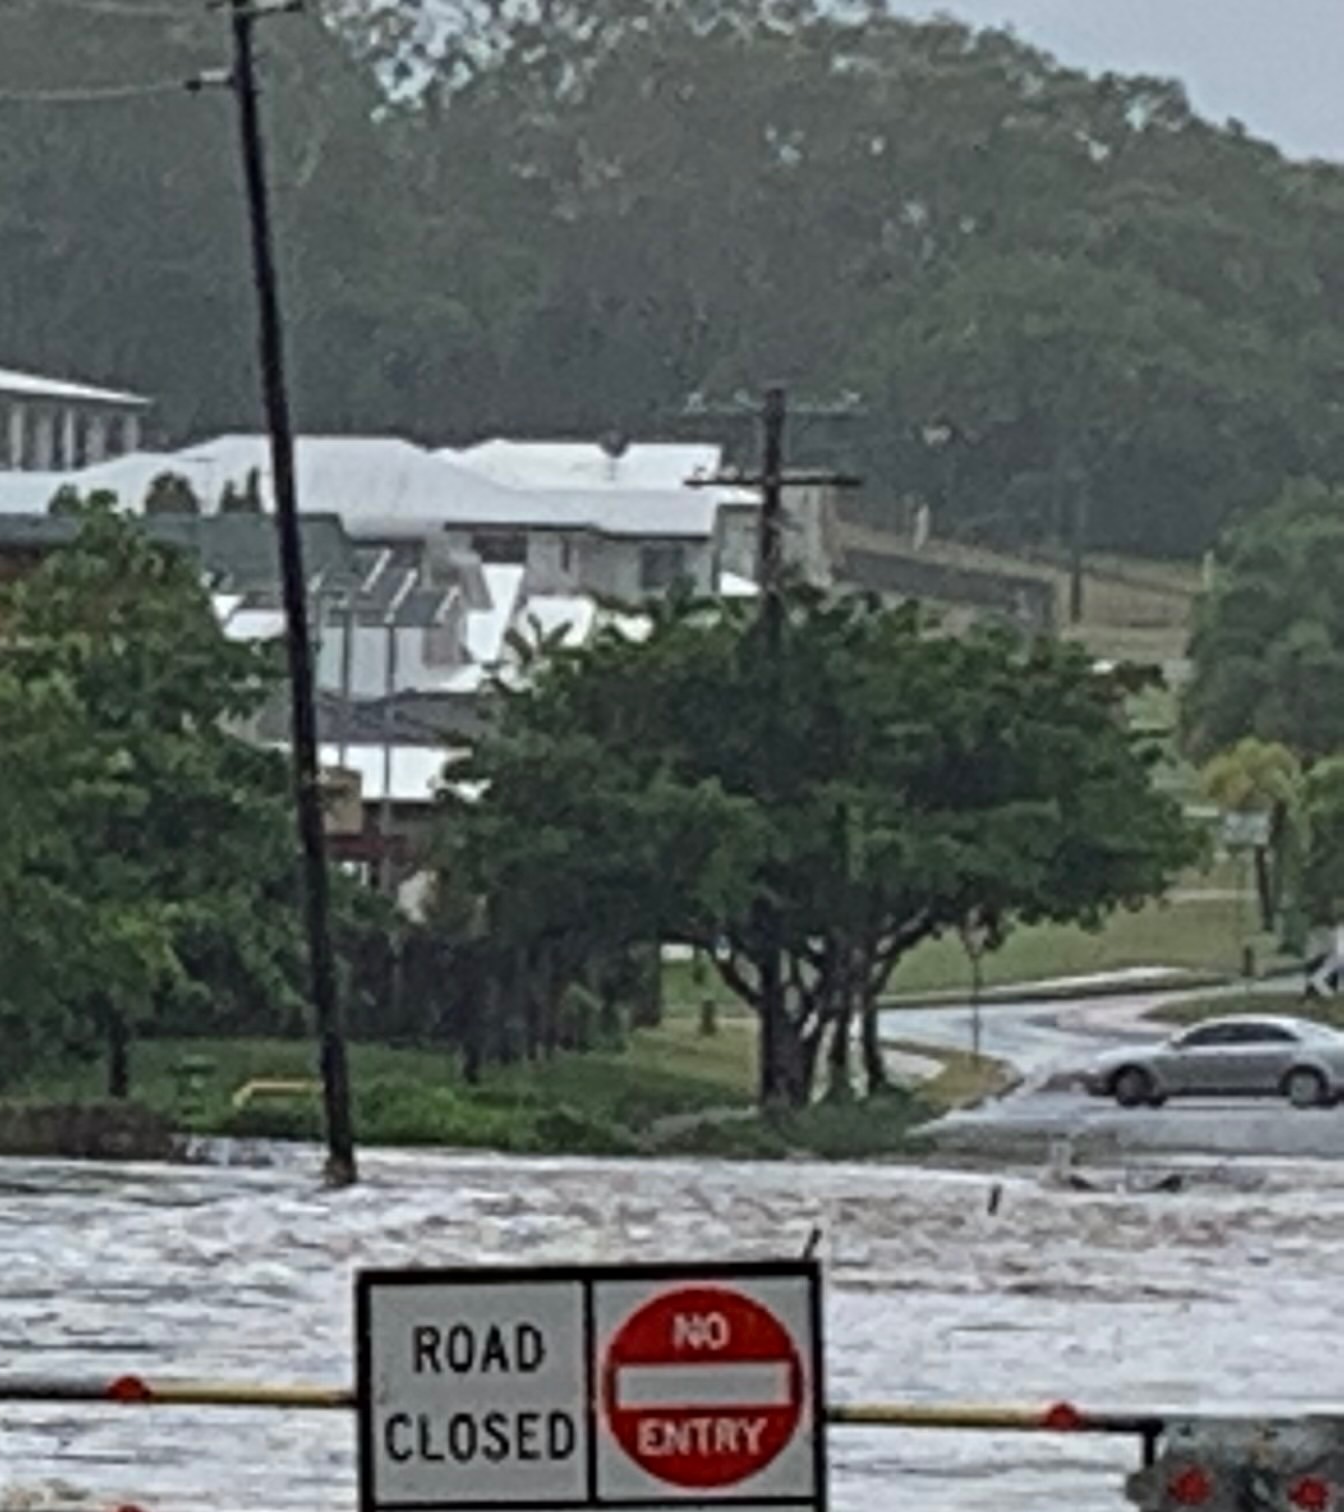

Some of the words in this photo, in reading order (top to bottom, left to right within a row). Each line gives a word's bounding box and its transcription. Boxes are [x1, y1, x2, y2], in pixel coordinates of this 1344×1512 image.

[414, 1323, 546, 1374] ROAD
[672, 1312, 730, 1350] NO
[384, 1412, 576, 1462] CLOSED
[637, 1417, 768, 1456] ENTRY
